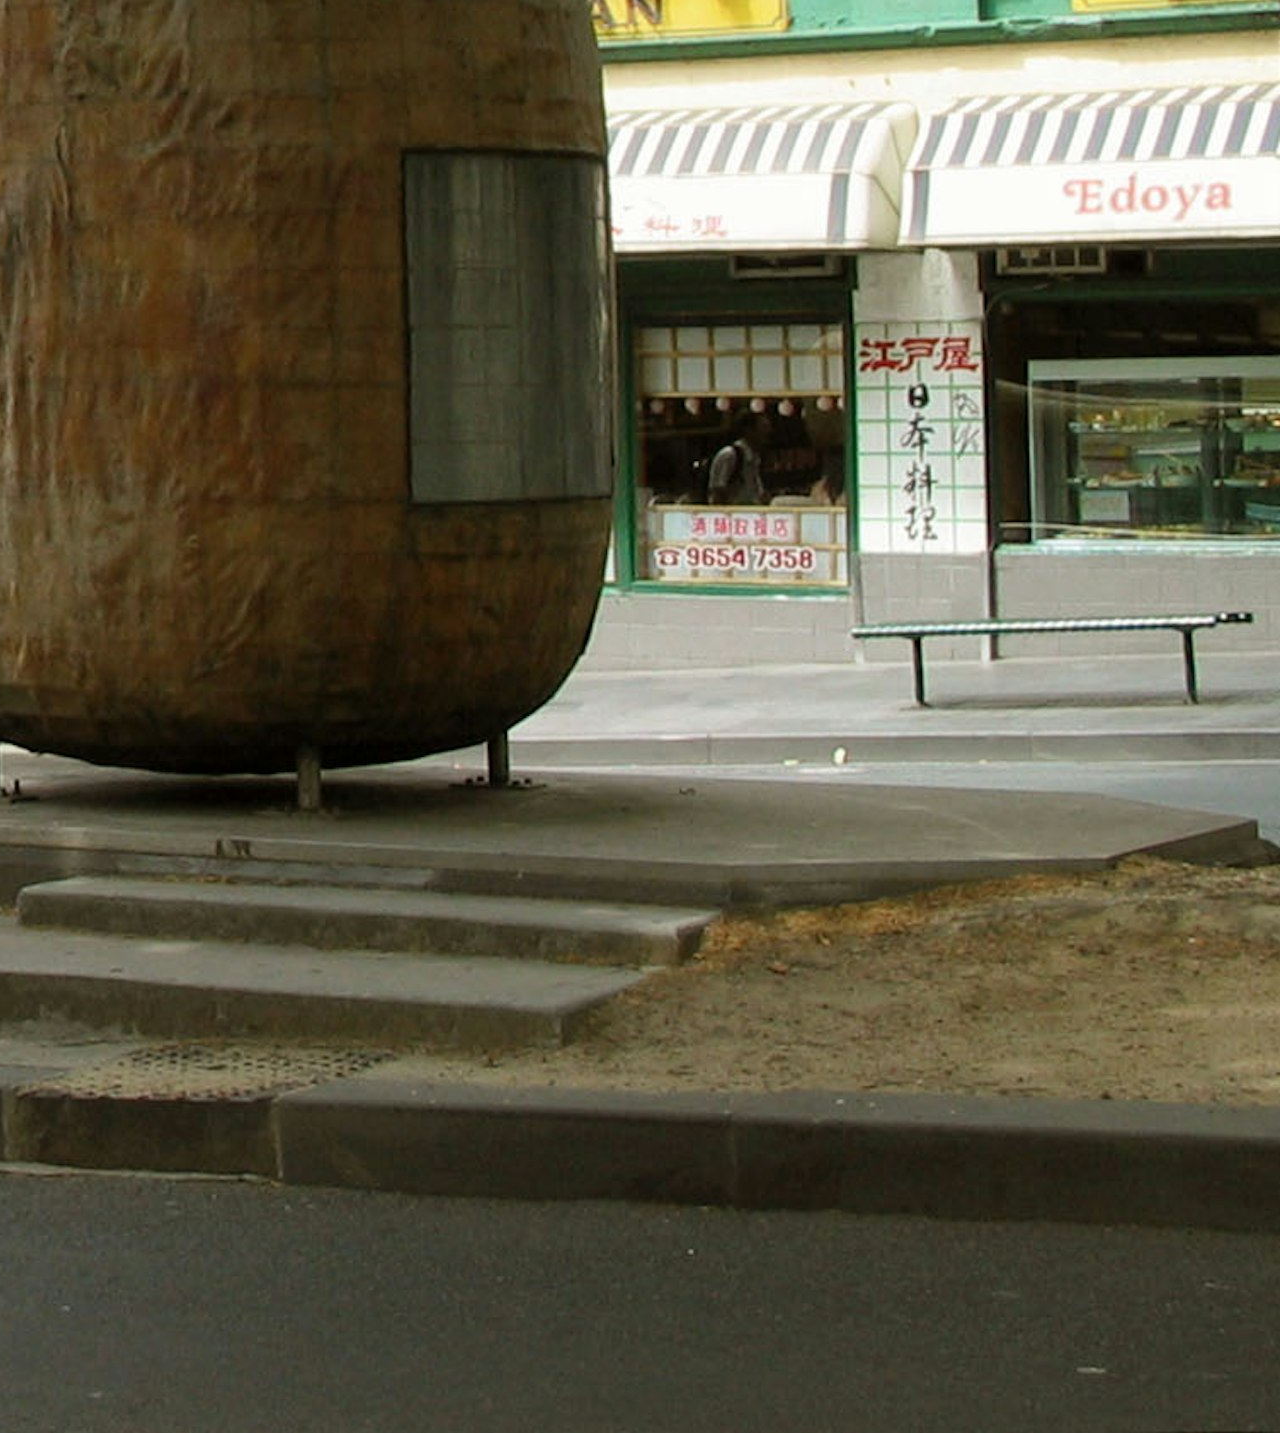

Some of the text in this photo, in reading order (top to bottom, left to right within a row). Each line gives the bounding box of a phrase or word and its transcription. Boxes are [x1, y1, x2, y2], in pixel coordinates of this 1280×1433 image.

[1062, 172, 1233, 222] Edoya
[900, 383, 938, 541] 日本料理
[686, 547, 813, 568] 9654 7358
